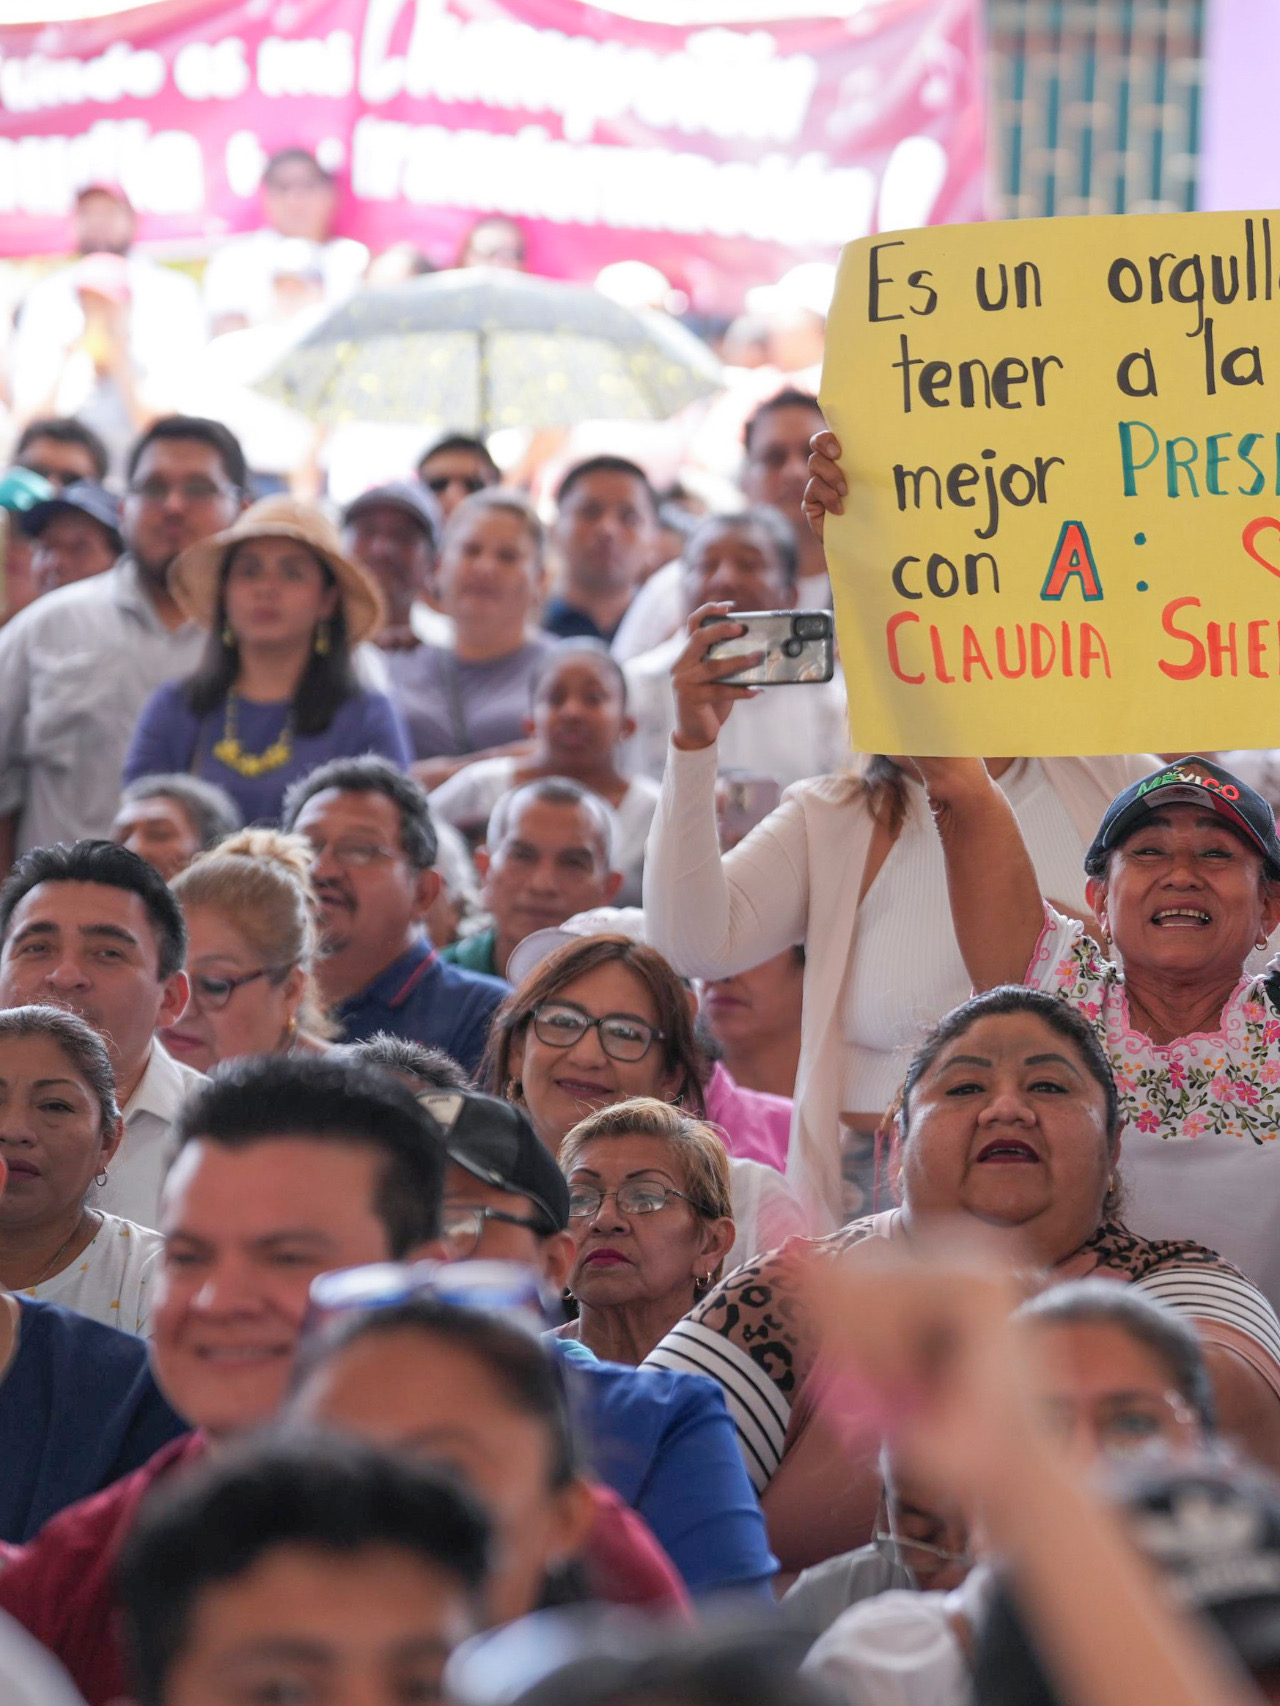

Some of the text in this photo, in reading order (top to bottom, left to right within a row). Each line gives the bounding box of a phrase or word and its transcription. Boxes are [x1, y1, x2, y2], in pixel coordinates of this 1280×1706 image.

[866, 240, 938, 324] Es
[975, 261, 1043, 312] un
[891, 332, 1065, 413] tener
[1115, 346, 1159, 398] a
[1203, 317, 1266, 396] la
[891, 447, 1066, 540] mejor
[891, 552, 1001, 601] con
[885, 610, 1113, 686] CLAUDIA
